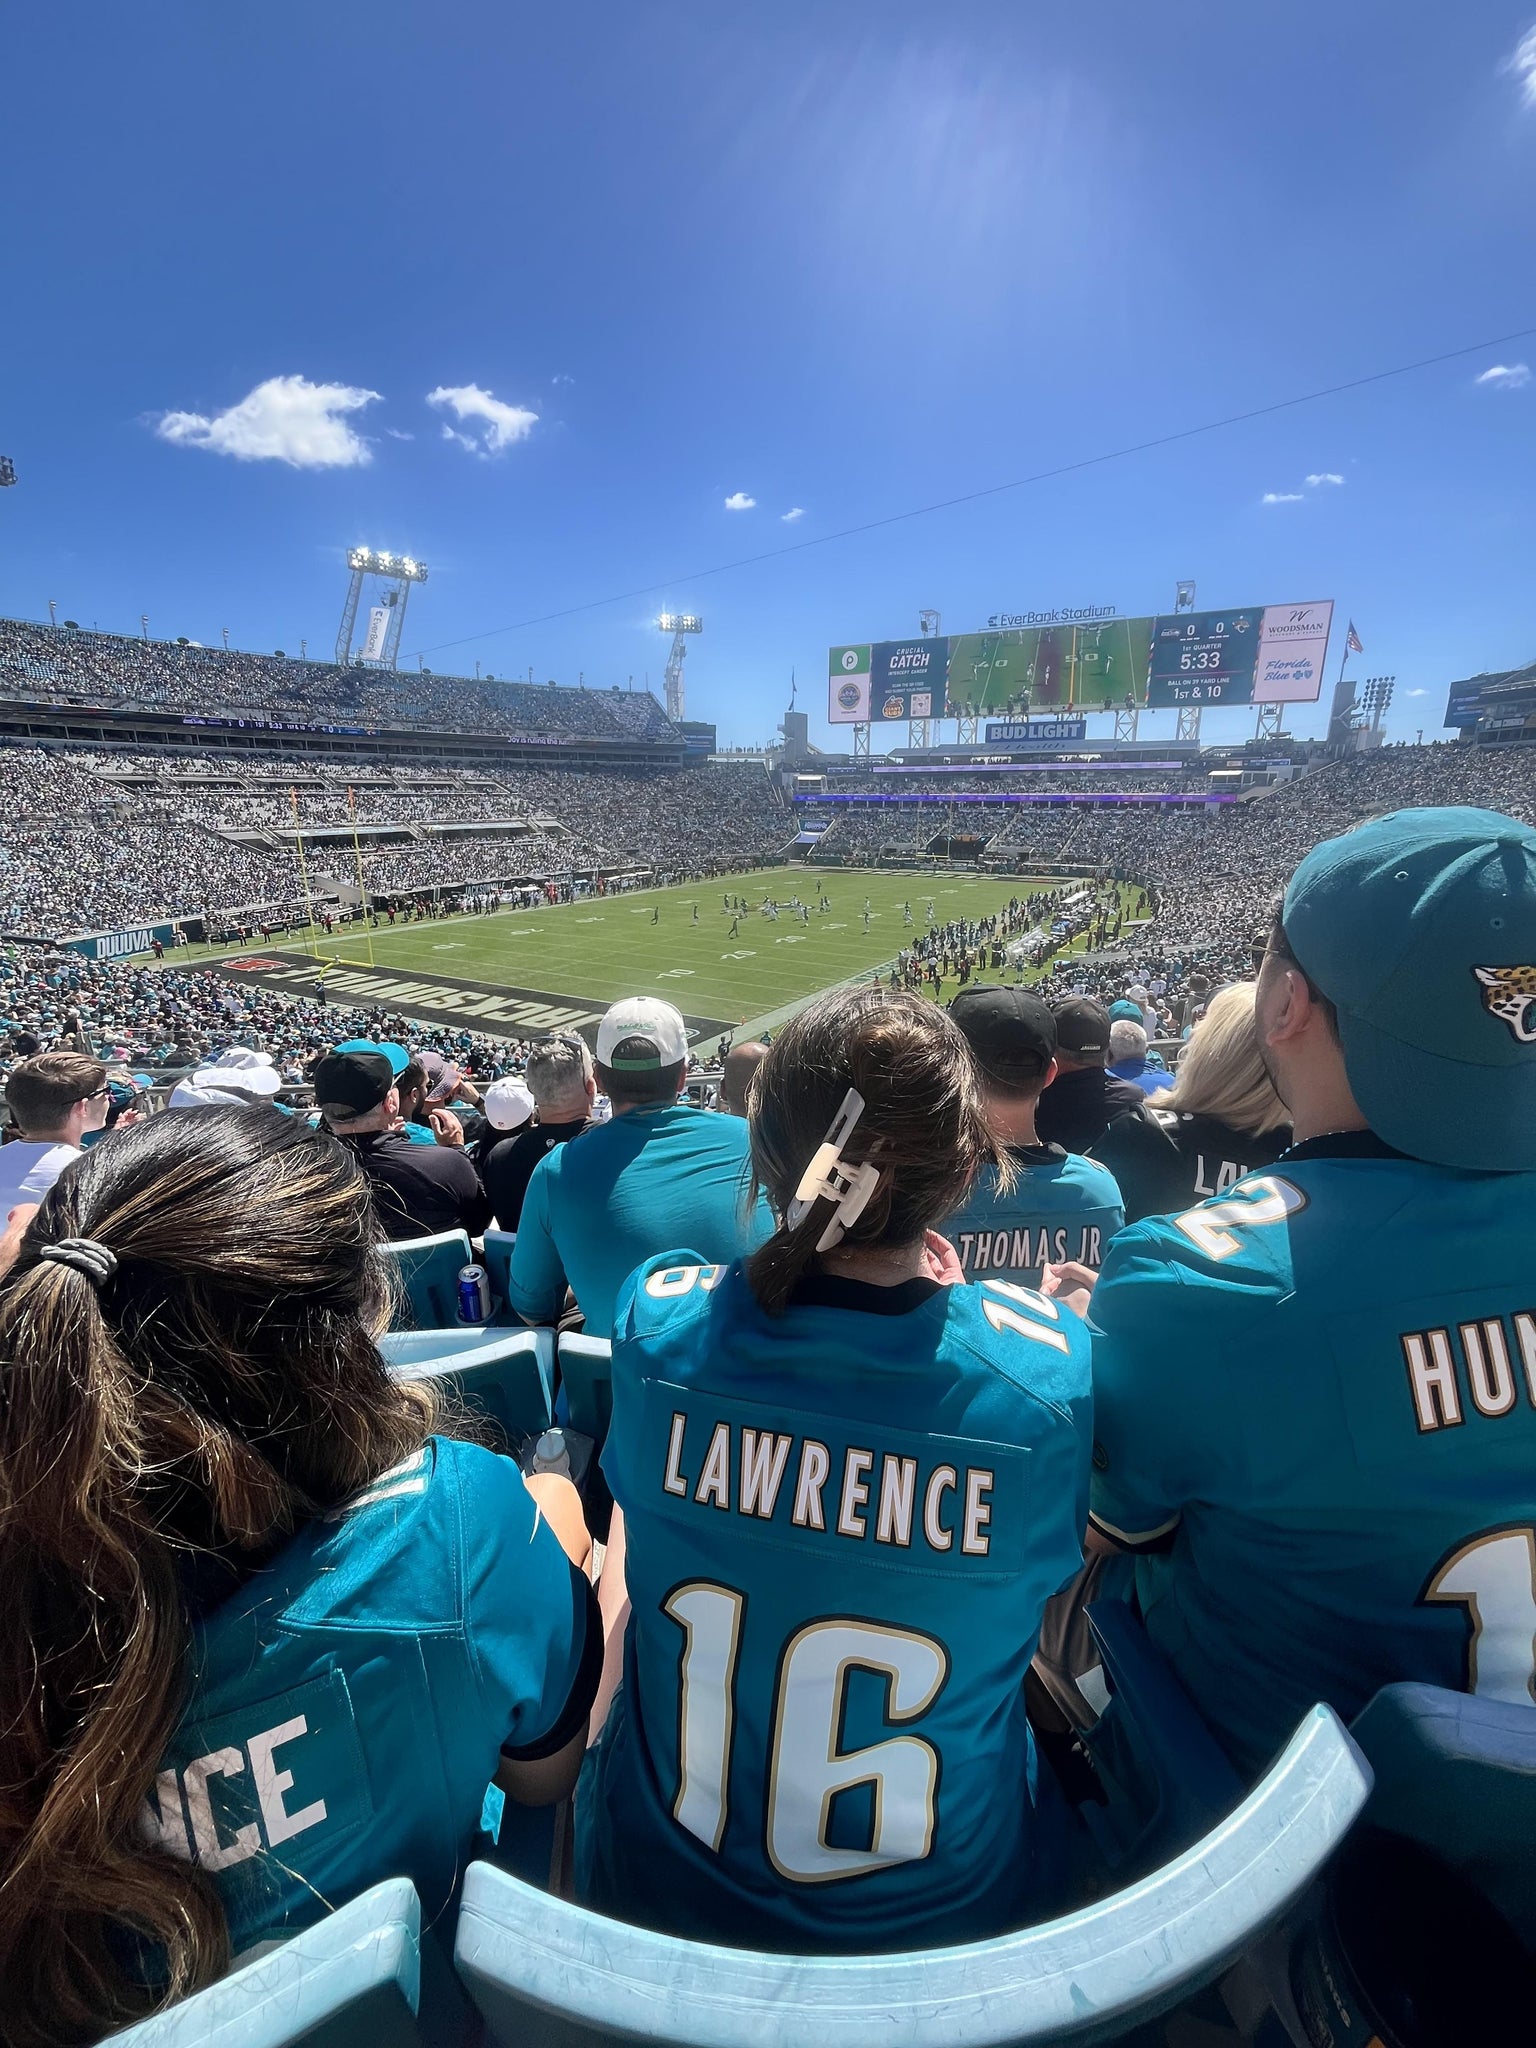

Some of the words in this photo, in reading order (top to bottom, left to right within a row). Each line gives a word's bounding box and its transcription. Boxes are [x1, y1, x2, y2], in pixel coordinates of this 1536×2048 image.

[1000, 609, 1060, 626] EverBank
[1061, 605, 1116, 620] Stadium
[1187, 624, 1195, 636] 0
[1216, 622, 1224, 633] 0
[1268, 622, 1324, 634] WOODSMAN
[367, 617, 381, 653] EverBank
[896, 647, 925, 655] CRUCIAL
[890, 653, 930, 668] CATCH
[1180, 652, 1220, 670] 5:33
[1265, 658, 1313, 670] Florida
[1264, 670, 1290, 681] Blue
[1174, 688, 1190, 699] 1ST
[1192, 686, 1202, 698] &
[1207, 685, 1221, 698] 10
[990, 726, 1027, 740] BUD
[1029, 723, 1081, 740] LIGHT
[656, 968, 696, 979] 10
[959, 1226, 1068, 1271] THOMAS
[1075, 1225, 1101, 1266] JR
[662, 1411, 995, 1557] LAWRENCE
[660, 1577, 949, 1884] 16
